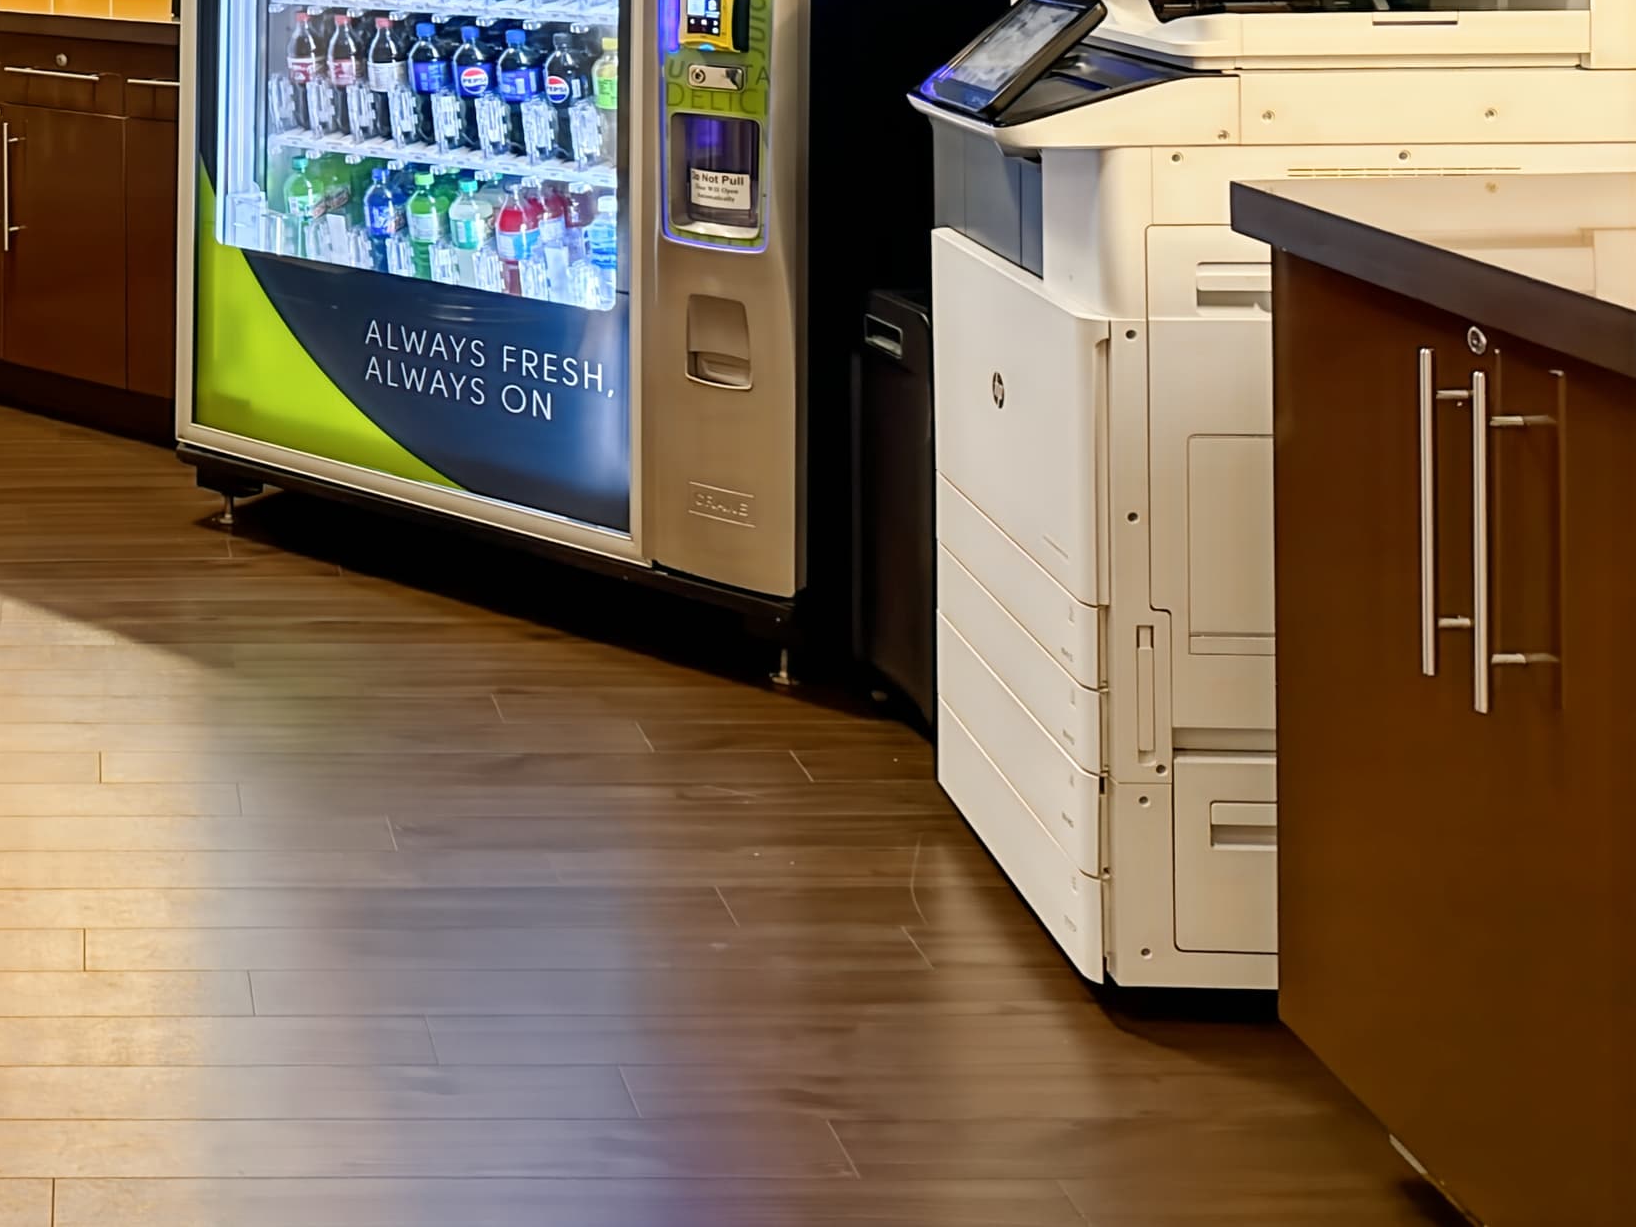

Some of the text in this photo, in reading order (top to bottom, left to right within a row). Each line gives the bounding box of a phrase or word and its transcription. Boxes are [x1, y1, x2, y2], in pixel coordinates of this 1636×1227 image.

[701, 173, 719, 185] Not
[721, 174, 745, 186] Pull
[365, 319, 616, 398] ALWAYS FRESH,
[365, 355, 553, 421] ALWAYS ON
